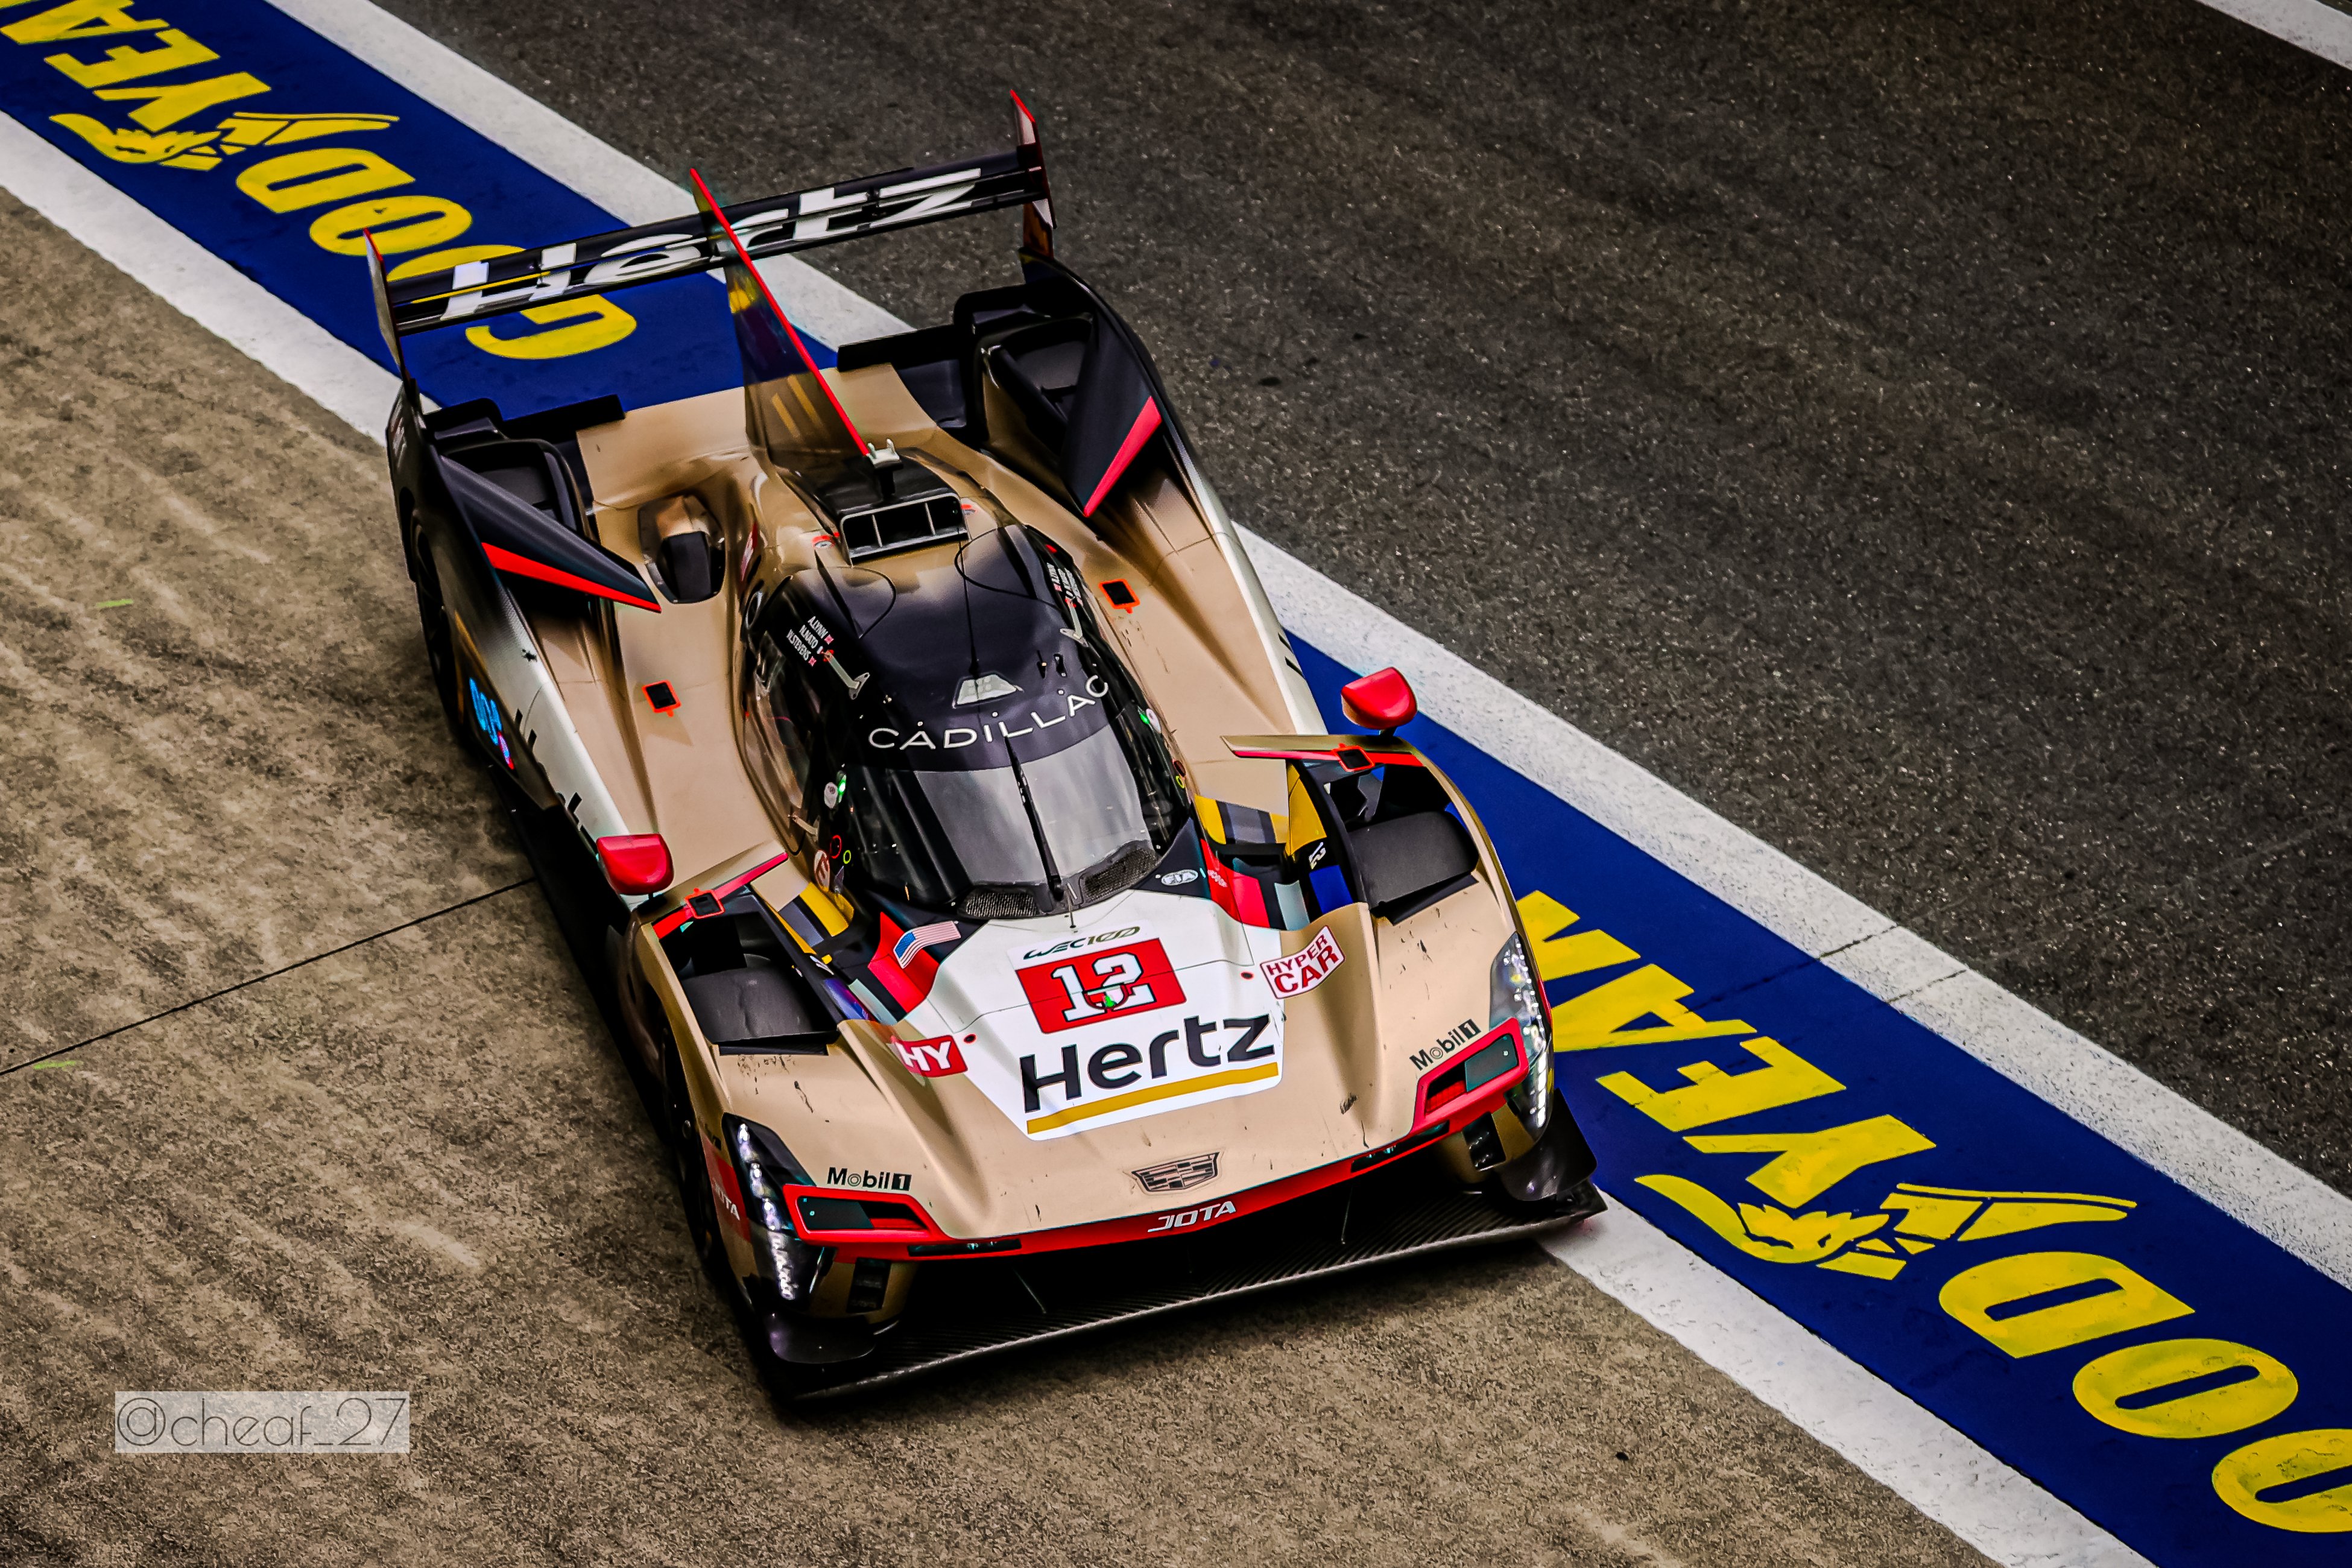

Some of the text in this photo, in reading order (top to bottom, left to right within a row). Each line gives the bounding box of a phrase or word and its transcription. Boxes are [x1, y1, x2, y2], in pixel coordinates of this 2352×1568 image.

[0, 0, 636, 359] GOODYEA
[868, 674, 1109, 750] CADILLAC
[1266, 934, 1329, 976] HYPER
[1274, 945, 1339, 993] CAR
[1051, 951, 1157, 1022] 12
[894, 1040, 951, 1072] HY
[1019, 1014, 1276, 1113] Hertz
[1148, 1200, 1236, 1233] JOTA
